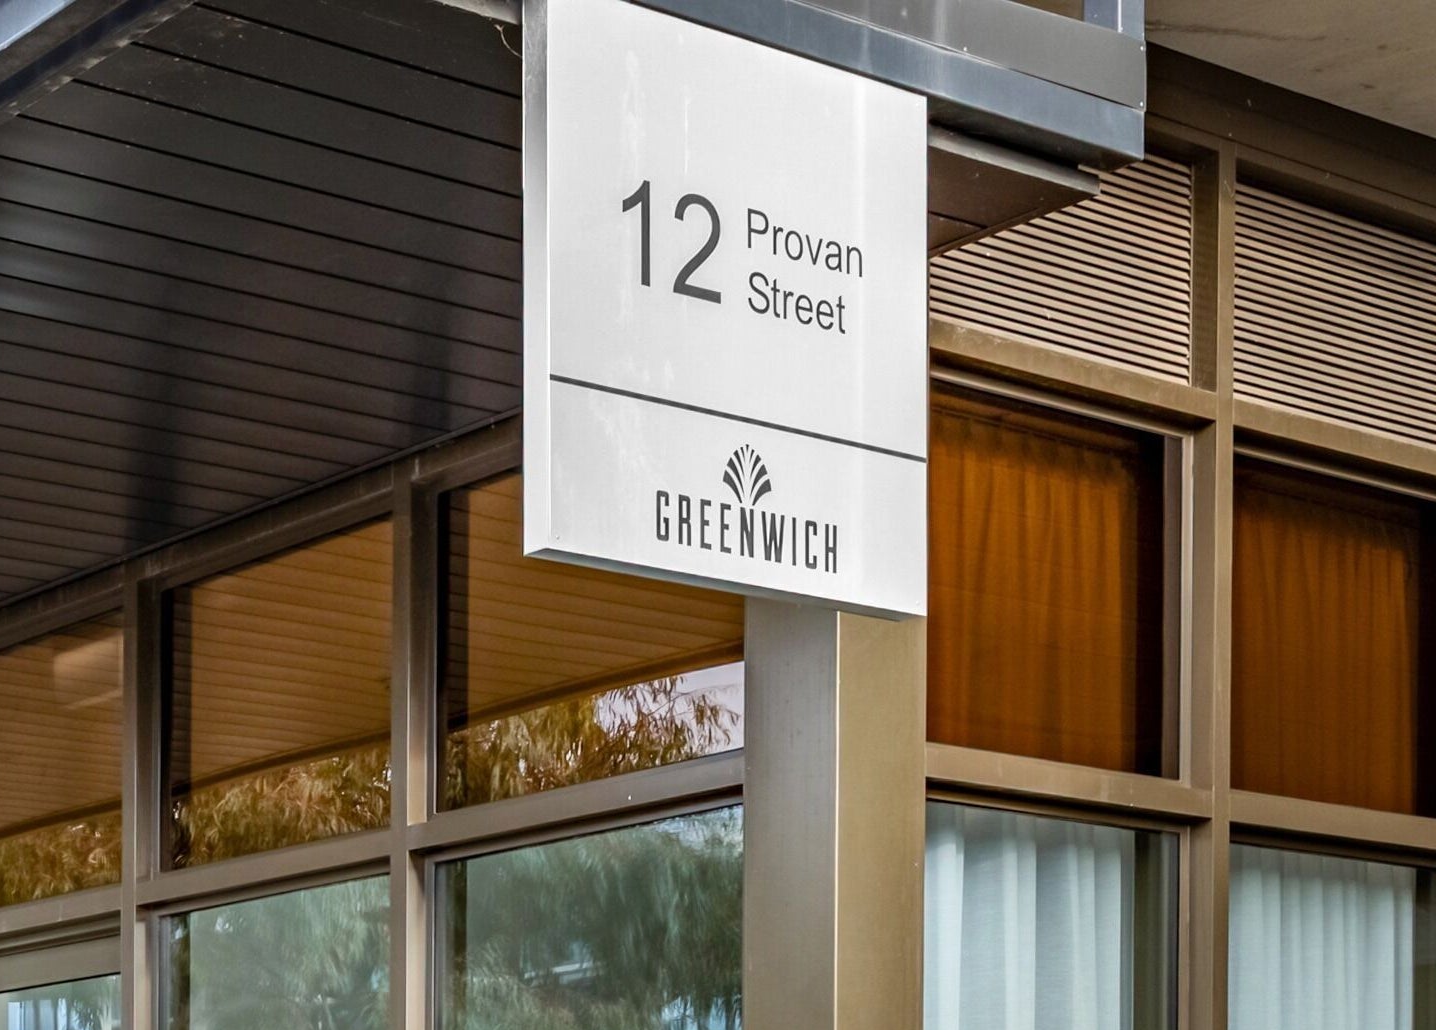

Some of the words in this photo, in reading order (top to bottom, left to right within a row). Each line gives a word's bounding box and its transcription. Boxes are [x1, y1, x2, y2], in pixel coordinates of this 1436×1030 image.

[622, 179, 722, 305] 12
[747, 207, 863, 278] Provan
[747, 271, 846, 335] Street
[656, 490, 838, 574] GREENWICH
